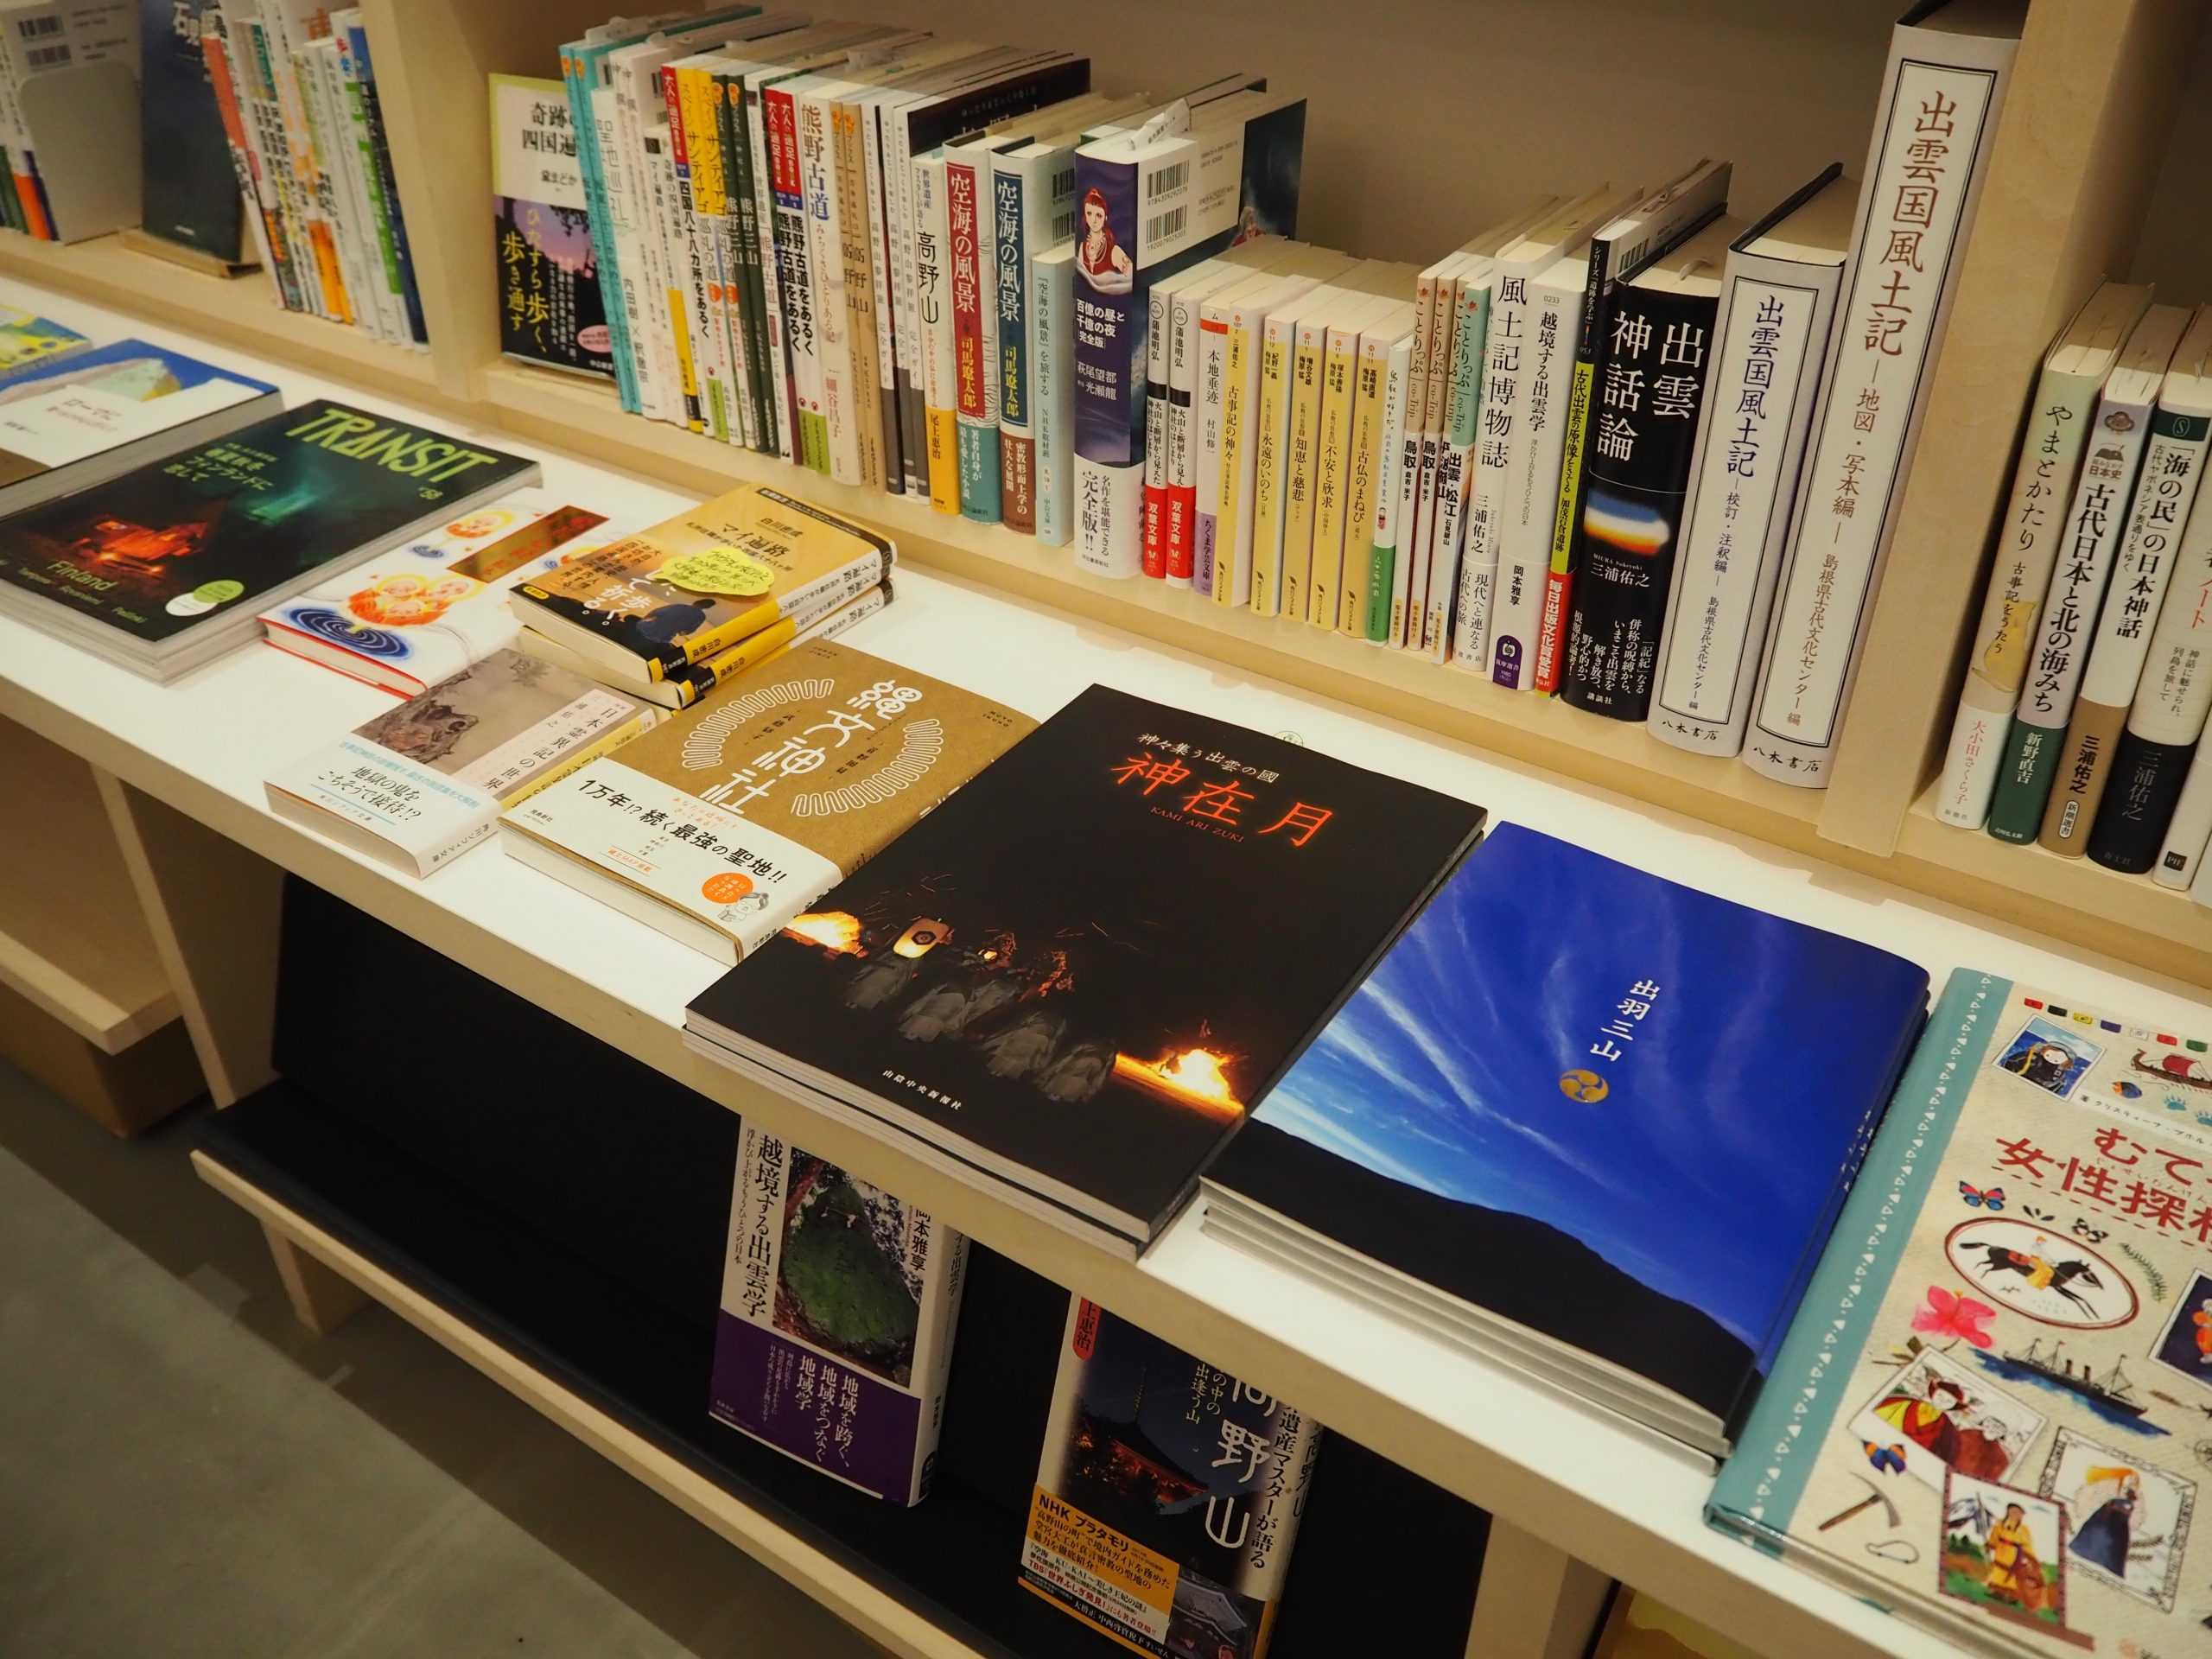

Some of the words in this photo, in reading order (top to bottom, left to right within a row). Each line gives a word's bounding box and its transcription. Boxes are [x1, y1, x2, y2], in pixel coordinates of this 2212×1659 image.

[801, 103, 830, 221] 熊野古道
[950, 173, 976, 314] 空海の風景
[997, 181, 1020, 322] 空海の風景
[1864, 90, 1957, 356] 出雲国風土記
[502, 231, 525, 332] 歩き通す
[791, 215, 813, 356] 熊野古道をあるく
[917, 231, 940, 324] 高野山
[1077, 298, 1125, 322] 百億の昼と
[1077, 315, 1116, 338] 千億の夜
[1174, 327, 1185, 368] 蒲池明弘
[1410, 302, 1427, 373] ことりっぷ
[1430, 303, 1446, 375] ことりっぷ
[1457, 315, 1473, 388] ことりっぷ
[961, 338, 977, 409] 司馬遼太郎
[1005, 346, 1020, 418] 司馬遼太郎
[1077, 361, 1117, 384] 萩尾望都
[1085, 381, 1117, 401] 光瀬龍
[1409, 384, 1420, 417] co-Trip
[1428, 385, 1439, 419] co-Trip
[1482, 274, 1528, 468] 風土記博物誌
[1529, 312, 1558, 432] 越境する出雲学
[1596, 310, 1654, 462] 神話論
[1651, 321, 1705, 420] 出雲
[1727, 295, 1785, 478] 出雲国風土記
[285, 409, 499, 482] TRANSIT
[1154, 402, 1162, 485] 火山と断層から見えた
[1177, 409, 1185, 487] 火山と断層から見え
[1224, 385, 1239, 461] 古事記の神々
[1404, 440, 1418, 468] 鳥取
[1422, 440, 1436, 469] 鳥取
[1004, 439, 1015, 493] 壮大な展開
[1016, 442, 1027, 515] 密教形而上学の
[1260, 433, 1274, 502] 永遠のいのち
[1292, 437, 1307, 502] 知恵と慈悲
[1321, 446, 1338, 509] 不安と欣求
[1352, 451, 1369, 523] 古仏のまねび
[1445, 452, 1462, 517] 出雲・松江
[2018, 405, 2073, 551] やまとかたり
[2088, 466, 2122, 480] 日本史
[1101, 475, 1111, 556] 名作を堪能できる
[1147, 502, 1159, 546] 双葉文庫
[1171, 500, 1183, 545] 双葉文庫
[1471, 494, 1489, 554] 三浦佑之
[2116, 444, 2196, 639] 「海の民」の日本神話
[47, 560, 119, 592] Finland
[1457, 568, 1471, 626] 古代への旅
[1590, 563, 1651, 588] 三浦佑之
[1994, 562, 2026, 654] 古事記をうたう
[2034, 484, 2116, 713] 古代日本と北の海みち
[1471, 574, 1489, 650] 現代へと連なる
[1693, 596, 1720, 698] 島根県古代文化センター
[1795, 553, 1840, 709] 島根県古代文化センター
[1578, 632, 1593, 682] 野心的かつ
[1605, 620, 1626, 691] いまこそ出雲を
[1636, 640, 1655, 695] 「記紀」なる
[483, 706, 620, 791] 日本霊異記の世界
[699, 679, 924, 815] 縄文神社
[1137, 733, 1280, 785] 神々集う出雲の國
[1662, 720, 1718, 741] 八木書店
[1753, 746, 1821, 772] 八木書店
[1955, 720, 1986, 805] 大小田さくら子
[2016, 732, 2043, 785] 新野直吉
[2069, 735, 2101, 795] 三浦佑之
[351, 766, 420, 802] 地獄の鬼を
[1111, 752, 1333, 847] 神在月
[2121, 749, 2162, 822] 三浦佑之
[1150, 806, 1182, 823] KAMI
[1186, 819, 1211, 831] ARI
[1212, 827, 1245, 843] ZUKI
[1590, 979, 1661, 1062] 出羽三山
[2094, 1128, 2212, 1186] むて
[742, 1134, 785, 1317] 越境する出雲学
[795, 1355, 817, 1411] 地域学
[814, 1364, 838, 1462] 地域をつなぐ
[1185, 1363, 1210, 1425] 出逢う山
[836, 1375, 859, 1469] 地域を跨ぐ、
[1039, 1494, 1071, 1522] NHK
[1076, 1516, 1128, 1552] ブラタモリ
